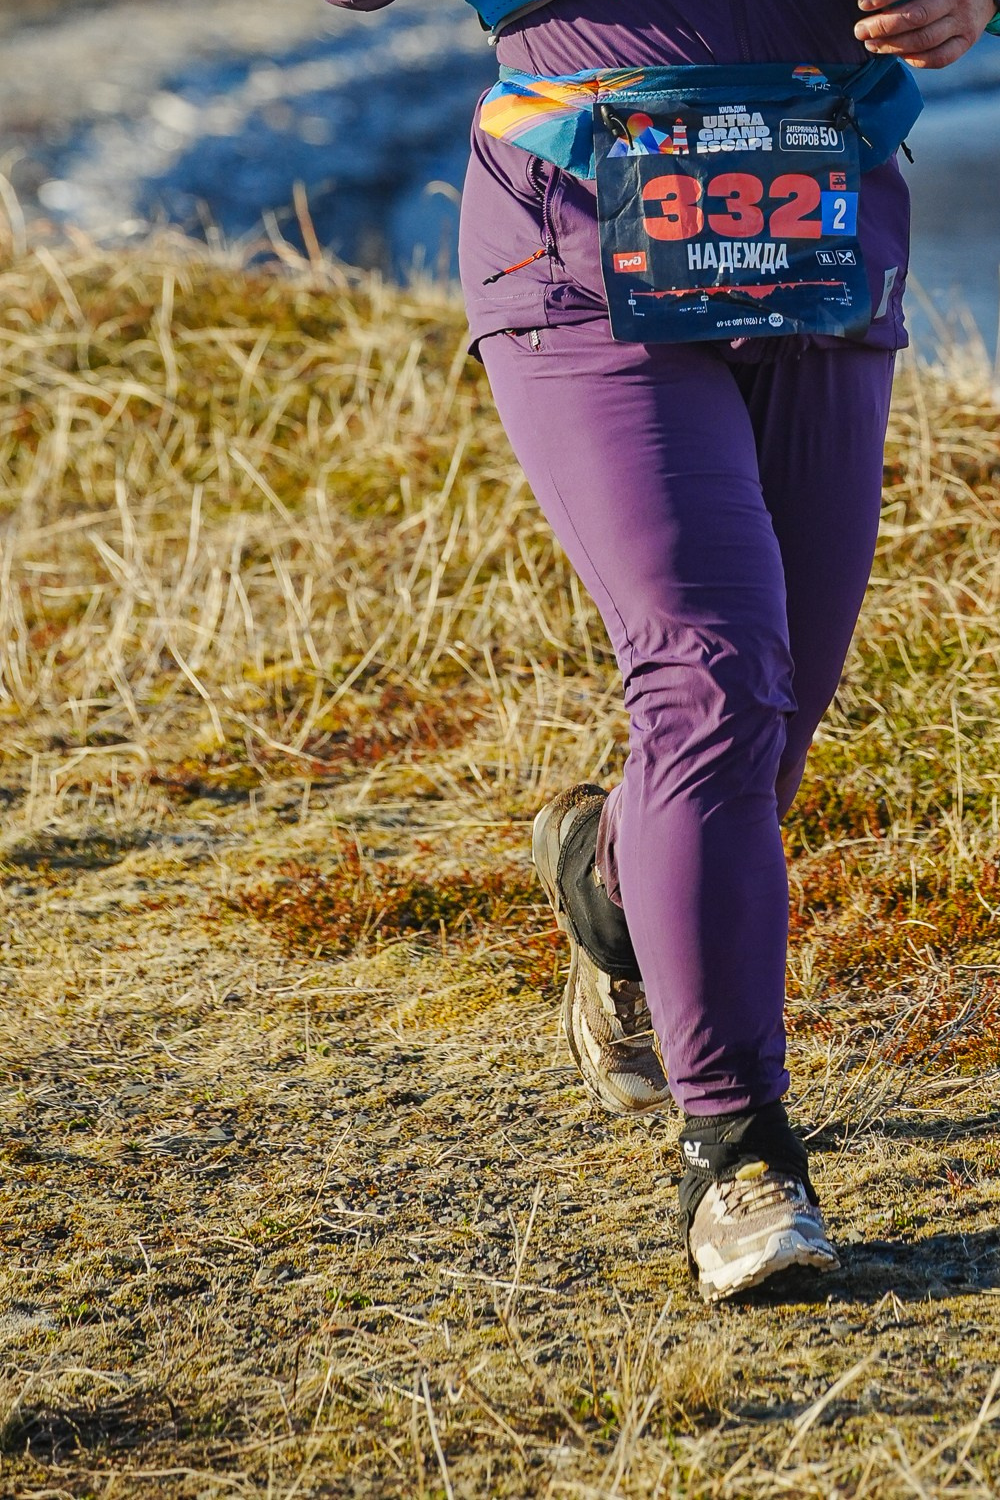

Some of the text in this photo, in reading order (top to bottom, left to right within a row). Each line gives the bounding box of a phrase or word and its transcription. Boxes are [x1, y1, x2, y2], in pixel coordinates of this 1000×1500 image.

[702, 112, 765, 129] ULTRA
[698, 125, 771, 142] GRAND
[785, 126, 839, 147] ОСТРОВ 50
[696, 137, 773, 154] ESCAPE
[642, 172, 823, 241] 332
[832, 198, 847, 230] 2
[686, 241, 790, 275] НАДЕЖДА
[820, 253, 833, 264] XL
[758, 317, 767, 325] +7
